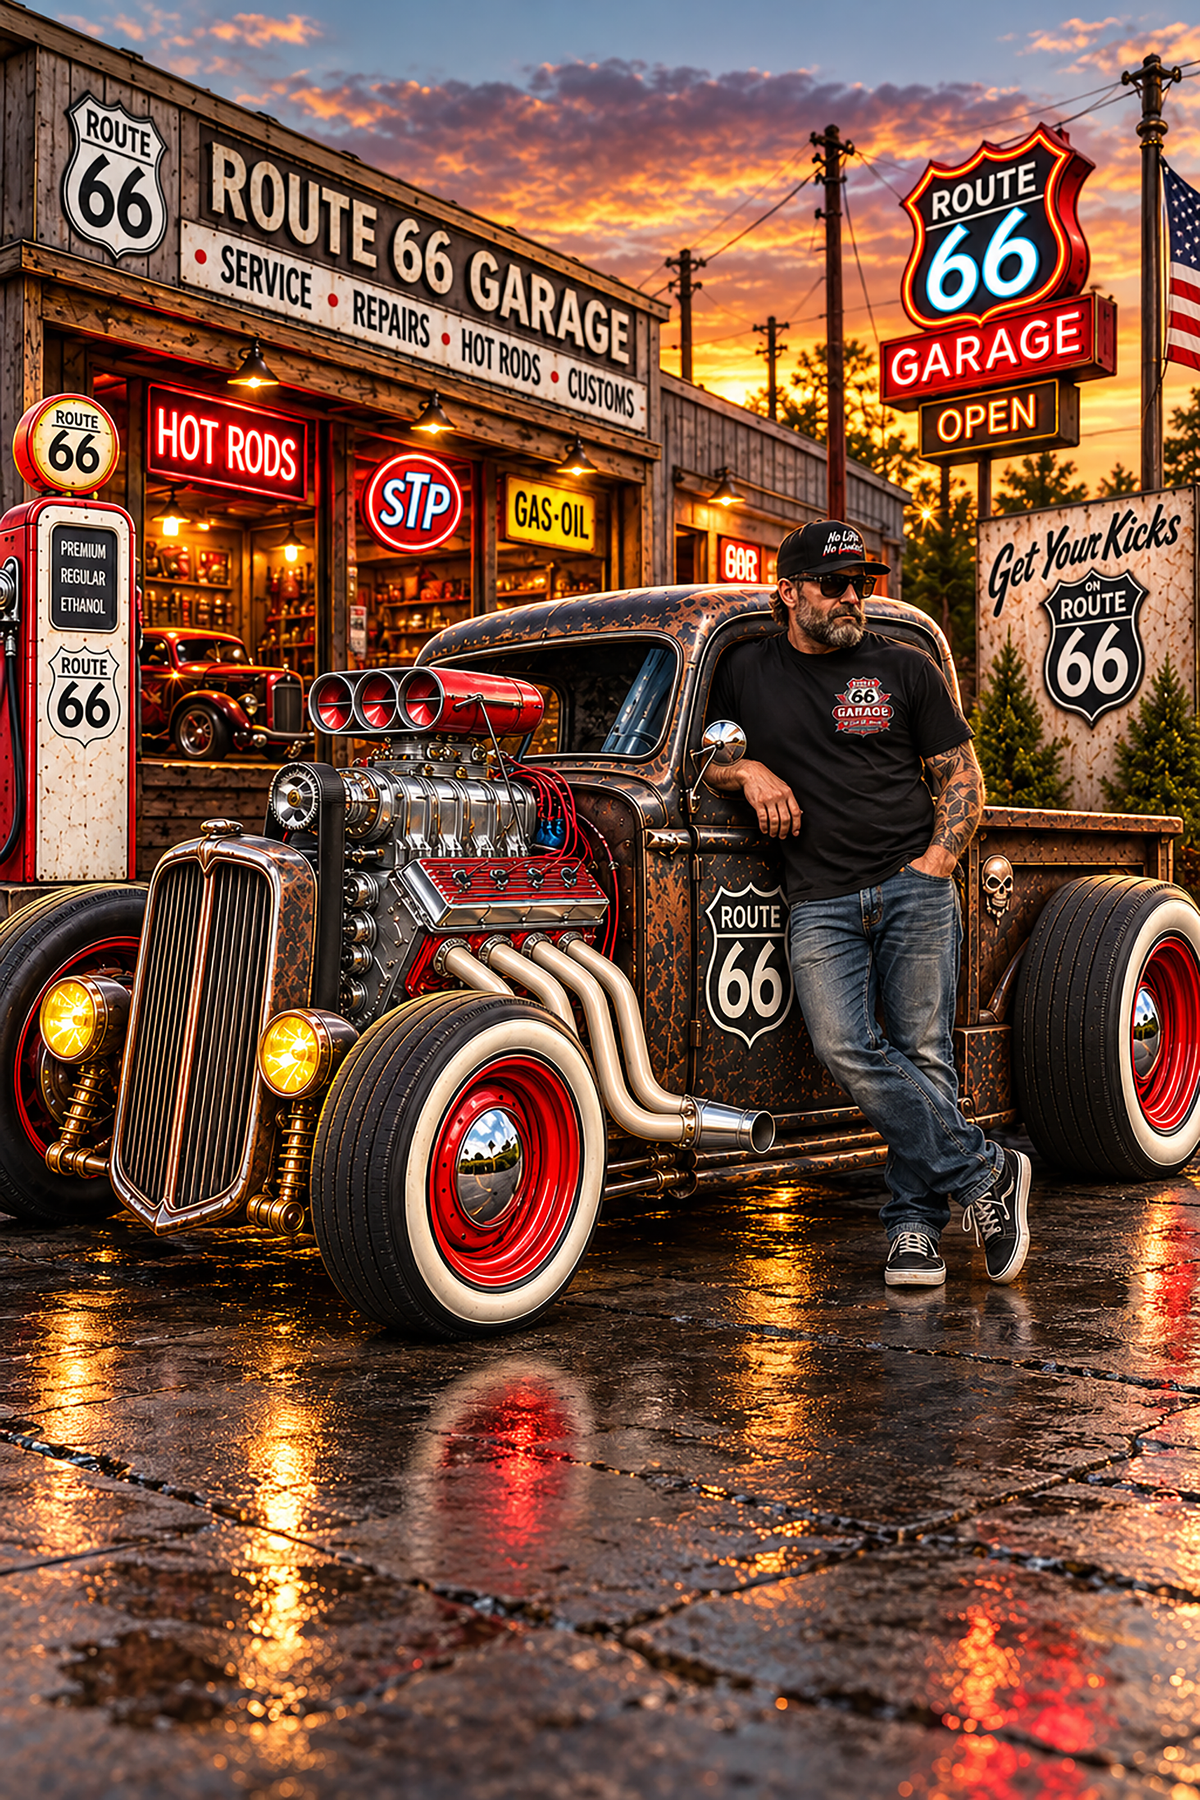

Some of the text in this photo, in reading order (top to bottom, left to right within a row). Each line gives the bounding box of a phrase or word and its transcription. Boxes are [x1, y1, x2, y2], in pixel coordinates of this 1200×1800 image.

[86, 108, 152, 158] ROUTE
[78, 153, 153, 239] 66
[931, 161, 1037, 220] ROUTE
[210, 141, 631, 366] ROUTE 66 GARAGE
[925, 206, 1040, 312] 66
[220, 245, 635, 419] SERVICE REPAIRS HOT RODS CUSTOMS
[890, 311, 1081, 387] GARAGE
[55, 409, 99, 430] ROUTE
[937, 393, 1037, 444] OPEN
[48, 429, 100, 474] 66
[157, 407, 297, 482] HOT RODS
[378, 471, 451, 531] STP
[60, 540, 107, 560] PREMIUM
[988, 503, 1182, 617] Get Your Kicks
[60, 568, 106, 587] REGULAR
[1085, 580, 1101, 592] ON
[60, 597, 106, 615] ETHANOL
[1060, 590, 1127, 620] ROUTE
[61, 657, 108, 677] ROUTE
[1056, 622, 1129, 698] 66
[57, 681, 111, 729] 66
[851, 690, 875, 703] 66
[720, 905, 781, 929] ROUTE
[717, 940, 783, 1019] 66
